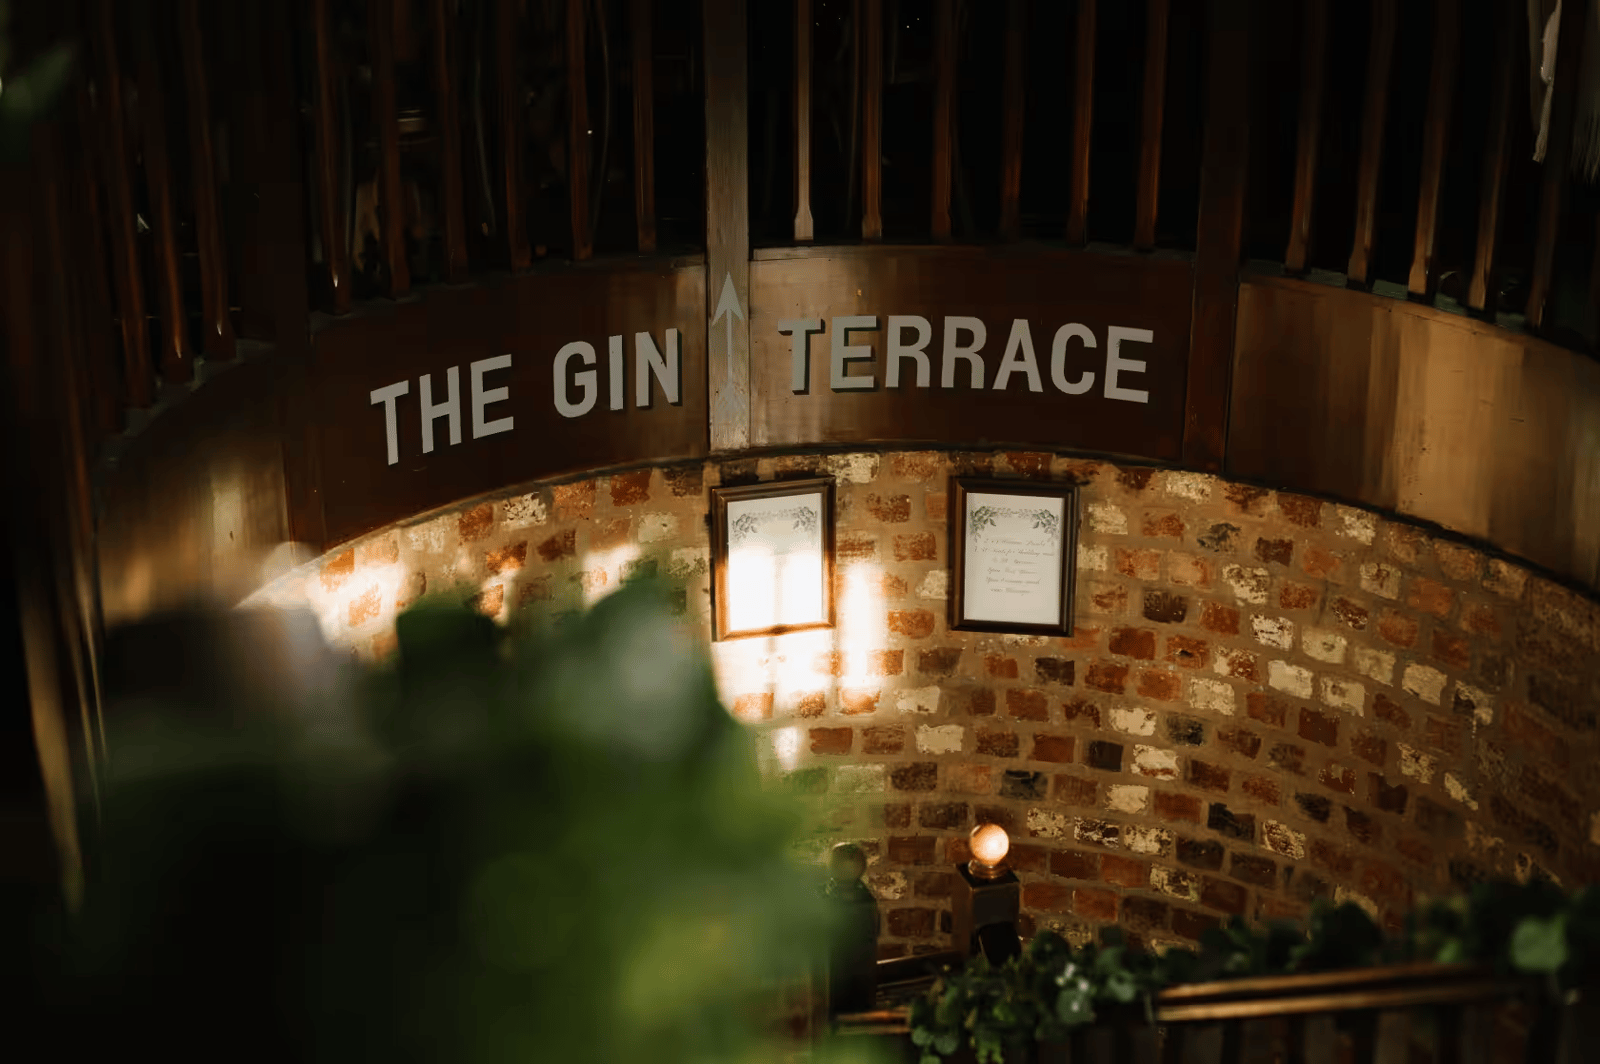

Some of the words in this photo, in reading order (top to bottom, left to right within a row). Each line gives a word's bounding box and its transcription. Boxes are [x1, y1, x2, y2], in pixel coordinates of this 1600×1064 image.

[370, 354, 515, 466] THE
[552, 328, 681, 418] GIN
[778, 314, 1154, 404] TERRACE
